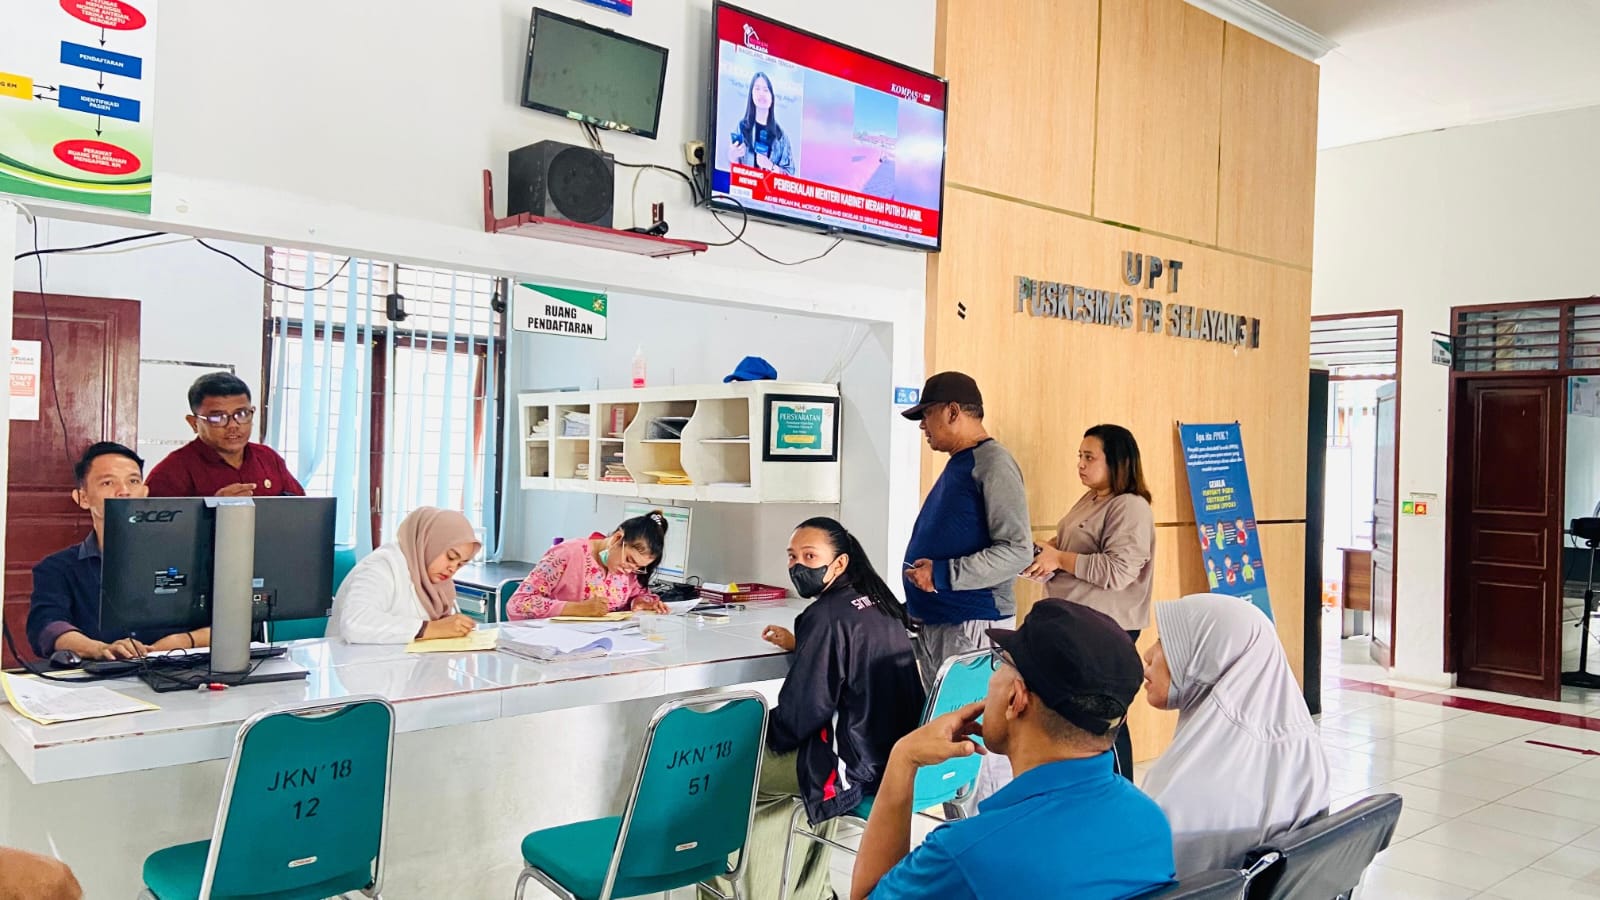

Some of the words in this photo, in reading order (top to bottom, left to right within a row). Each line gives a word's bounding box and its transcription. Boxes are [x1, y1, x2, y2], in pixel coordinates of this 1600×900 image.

[80, 54, 124, 68] PENDAFTARAN
[891, 83, 919, 98] KOMPAS
[80, 95, 120, 108] IDENTIFIKASI
[89, 102, 111, 111] PASIEN
[68, 150, 91, 159] RUANG
[92, 154, 127, 165] PELAYANAN
[83, 148, 112, 157] PERAWAT
[732, 166, 764, 179] BREAKING
[738, 176, 758, 186] NEWS
[774, 177, 814, 198] PEMBEKALAN
[815, 186, 840, 204] MENTERI
[840, 192, 865, 210] KABINET
[865, 198, 884, 214] MERAH
[884, 203, 900, 216] PUTIH
[1122, 250, 1182, 294] UPT
[545, 304, 576, 318] RUANG
[1014, 275, 1134, 330] PUSKESMAS
[1136, 298, 1162, 334] PB
[1166, 304, 1248, 347] SELAYANG
[1248, 318, 1260, 349] II
[528, 316, 592, 334] PENDAFTARAN
[780, 412, 820, 422] PERSYARATAN
[1196, 432, 1204, 444] Apa
[129, 510, 182, 523] acer
[266, 759, 352, 791] JKN'18
[688, 774, 710, 796] 51
[294, 798, 320, 820] 12
